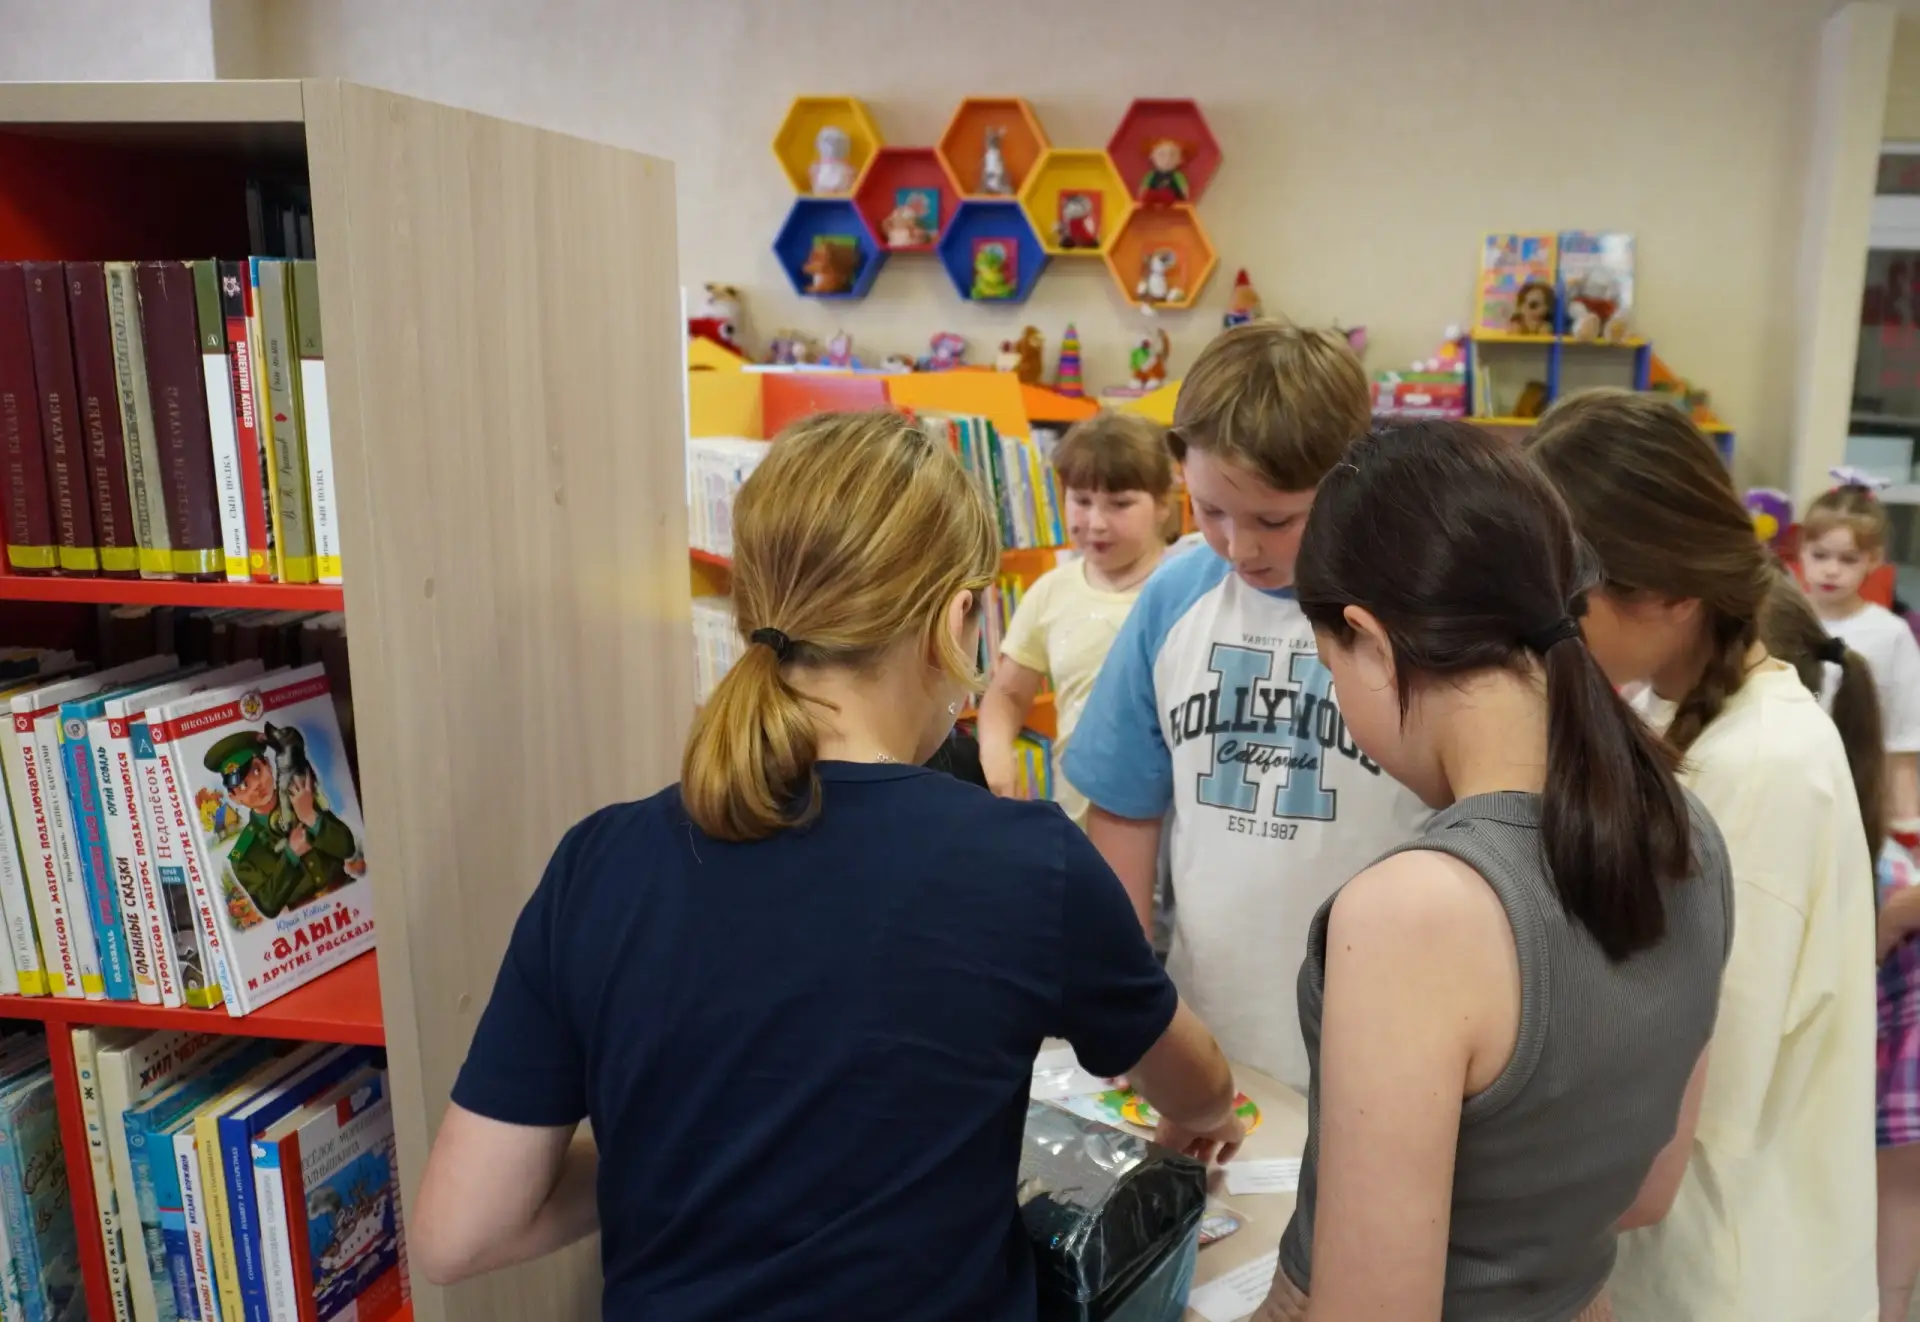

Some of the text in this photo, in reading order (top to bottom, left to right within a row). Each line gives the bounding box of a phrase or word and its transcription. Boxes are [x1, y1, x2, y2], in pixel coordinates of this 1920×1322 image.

[236, 341, 251, 393] ВАЛЕНТИН
[50, 393, 66, 454] КАТАЕВ
[241, 393, 254, 428] КАТАЕВ
[88, 396, 115, 547] АЛЕНТИН КАТАЕВ
[223, 454, 234, 490] ПОЛКА
[1242, 633, 1318, 650] VARSITY LEAG
[180, 707, 234, 731] ШКОЛЬНАЯ
[1169, 686, 1381, 777] HOLLYWOO
[96, 746, 118, 817] ЮРИЙ КОВАЛЬ
[1216, 739, 1319, 774] California
[144, 765, 173, 861] Недопёсок
[1227, 814, 1299, 841] EST.1987
[115, 856, 137, 908] СКАЗКИ
[180, 831, 202, 884] ДРУГИЕ
[54, 912, 76, 987] КУРОЛЕСОВ
[151, 922, 173, 995] КУРОЛЕСОВ
[262, 951, 313, 984] ДРУГИЕ
